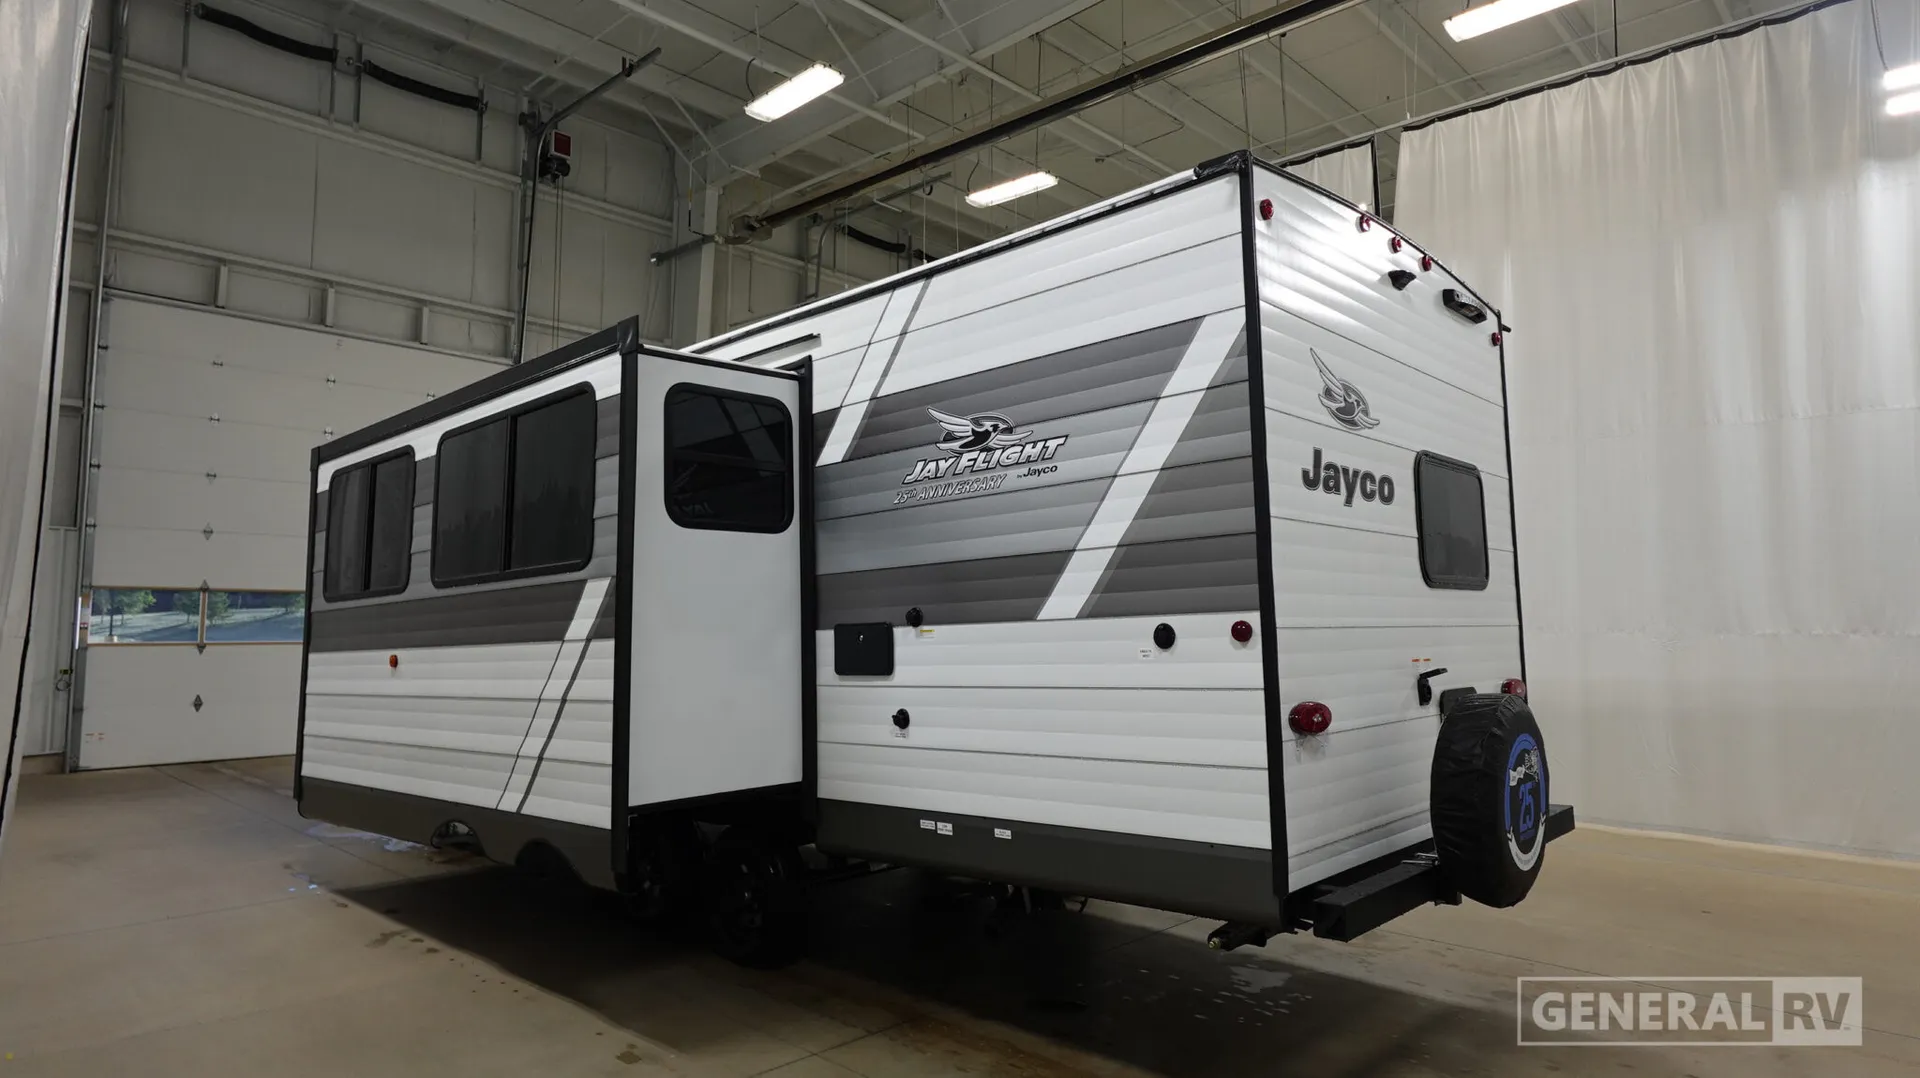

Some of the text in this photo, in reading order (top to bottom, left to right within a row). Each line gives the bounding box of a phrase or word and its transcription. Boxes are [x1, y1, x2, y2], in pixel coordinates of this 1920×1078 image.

[901, 434, 1069, 485] JAY FLIGHT
[1023, 464, 1059, 478] Jayco
[1301, 446, 1395, 508] Jayco
[893, 473, 1007, 505] 25th ANNIVERSARY
[1519, 783, 1535, 832] 25
